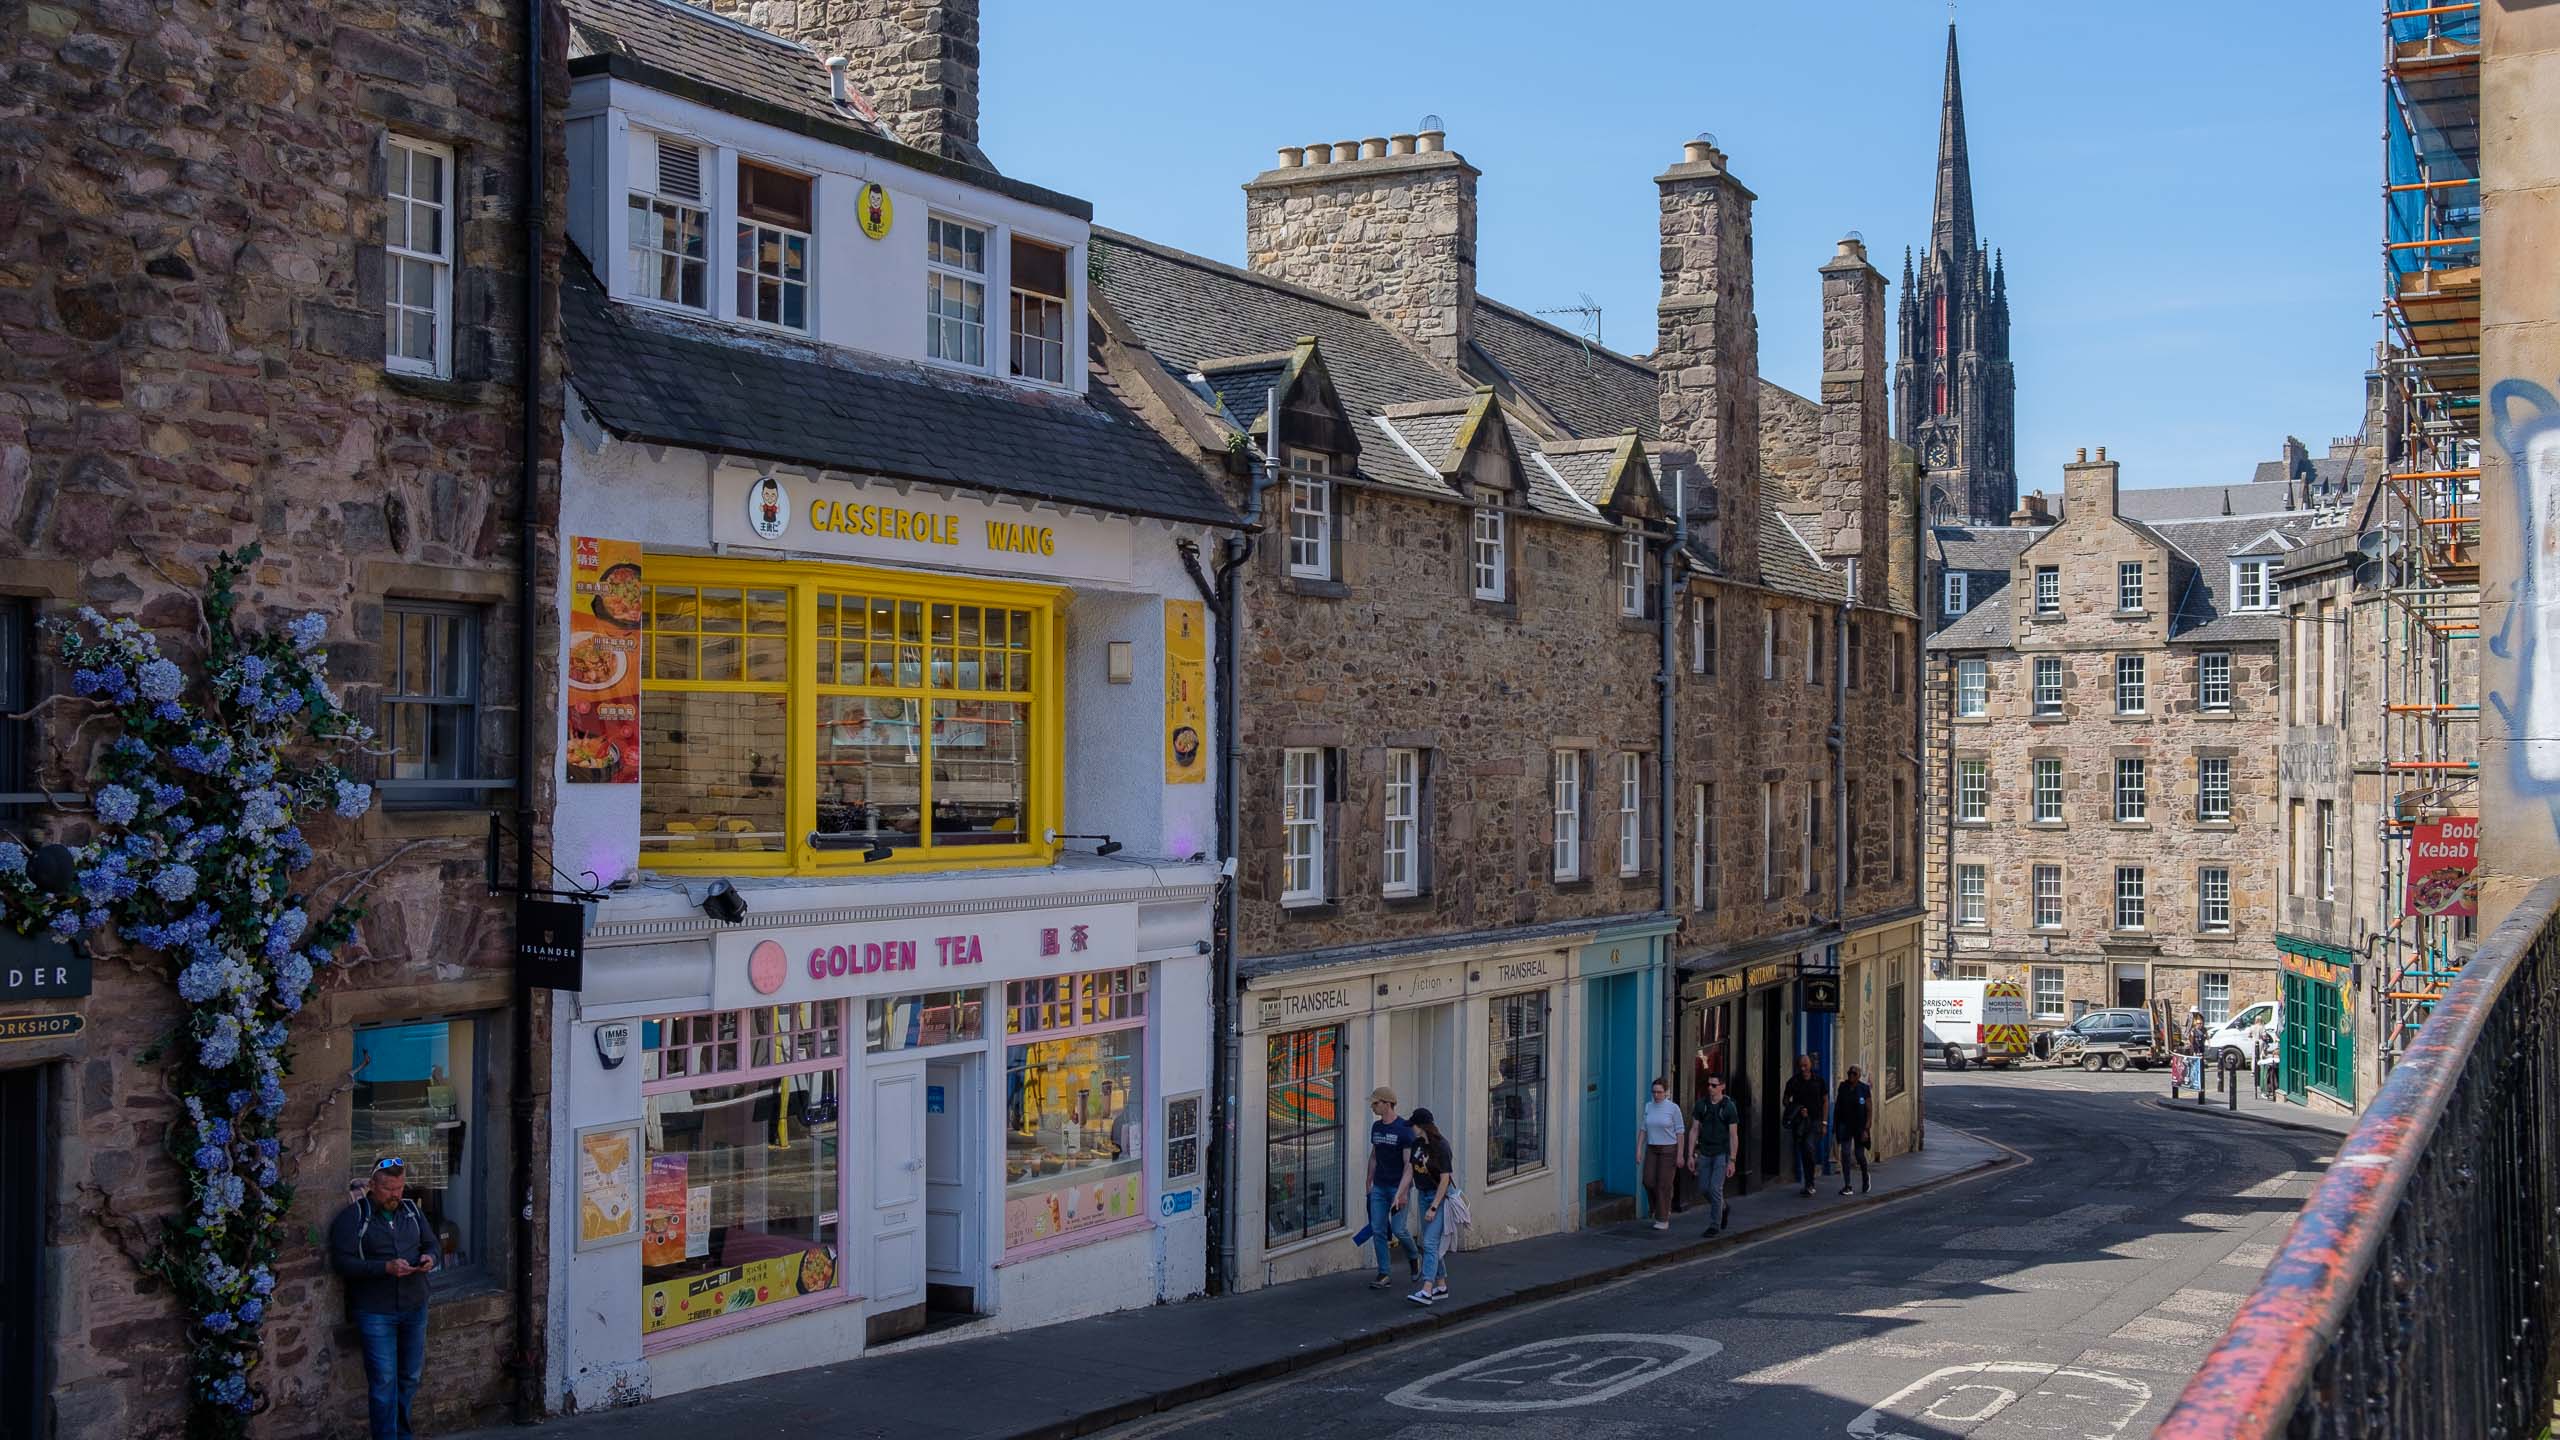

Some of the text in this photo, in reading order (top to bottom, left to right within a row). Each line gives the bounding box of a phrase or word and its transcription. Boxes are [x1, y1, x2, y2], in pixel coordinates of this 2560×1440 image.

[810, 499, 1056, 557] CASSEROLE WANG
[2418, 842, 2468, 857] Kebab
[521, 944, 576, 957] ISLANDER
[807, 940, 916, 980] GOLDEN
[935, 935, 983, 967] TEA
[9, 967, 67, 987] DER
[1498, 960, 1547, 982] TRANSREAL
[1409, 973, 1441, 997] fiction
[1283, 989, 1349, 1015] TRANSREAL
[605, 1028, 628, 1039] IMMS
[1460, 1352, 1661, 1387] 20
